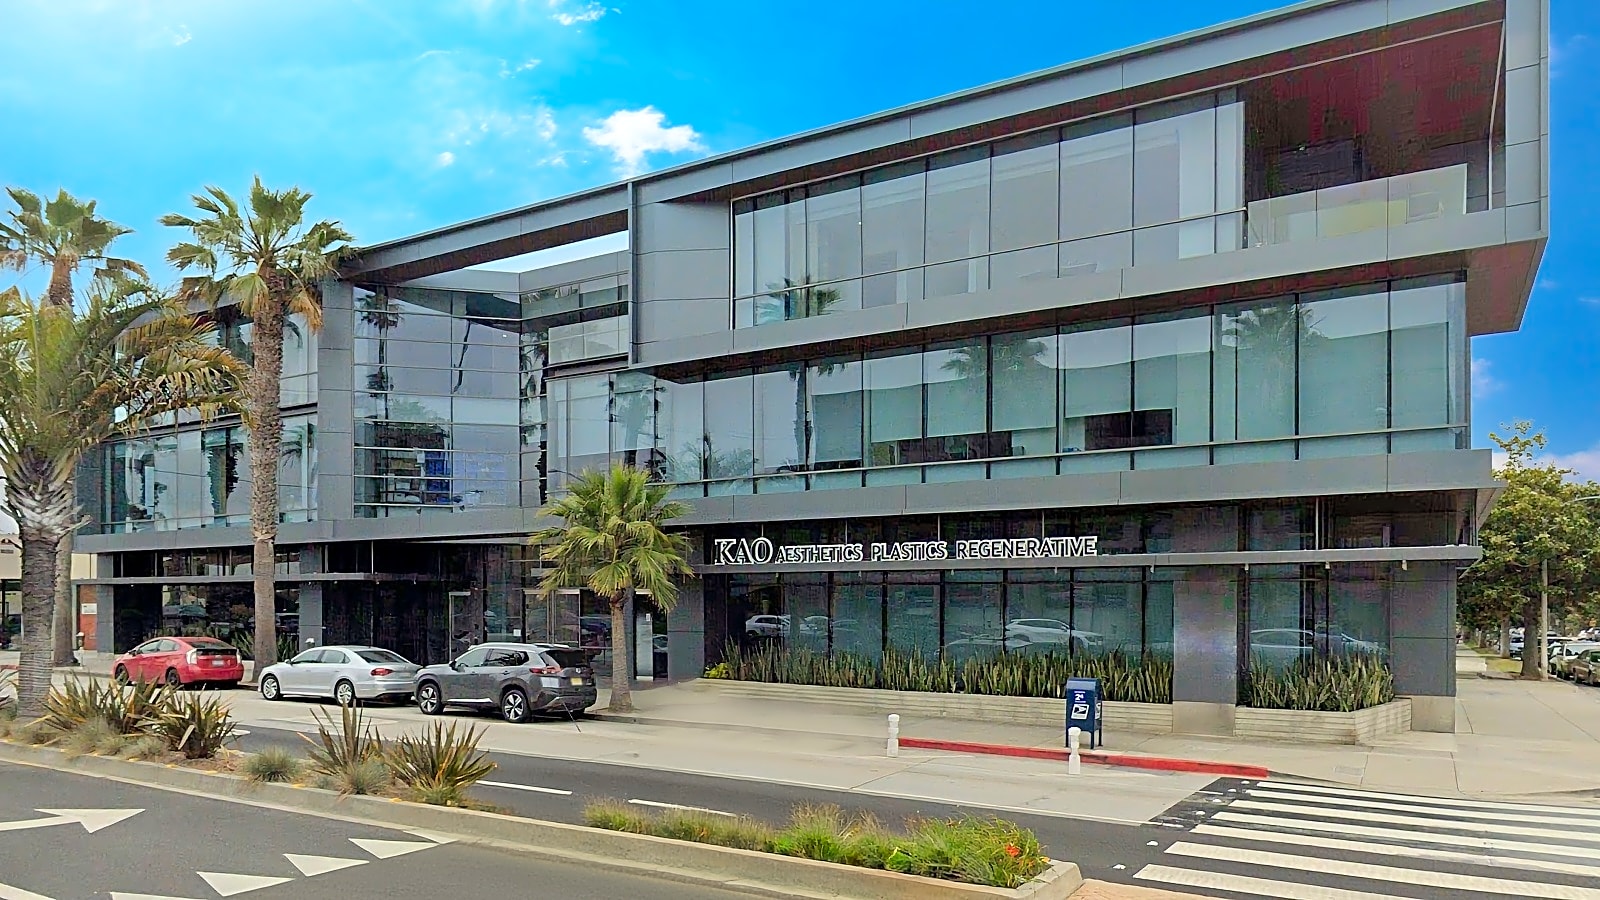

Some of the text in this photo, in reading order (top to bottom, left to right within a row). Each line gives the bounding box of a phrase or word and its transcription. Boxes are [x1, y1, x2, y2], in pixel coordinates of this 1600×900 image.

[714, 536, 1098, 565] KAO AESTHETICS PLASTICS REGENERATIVE
